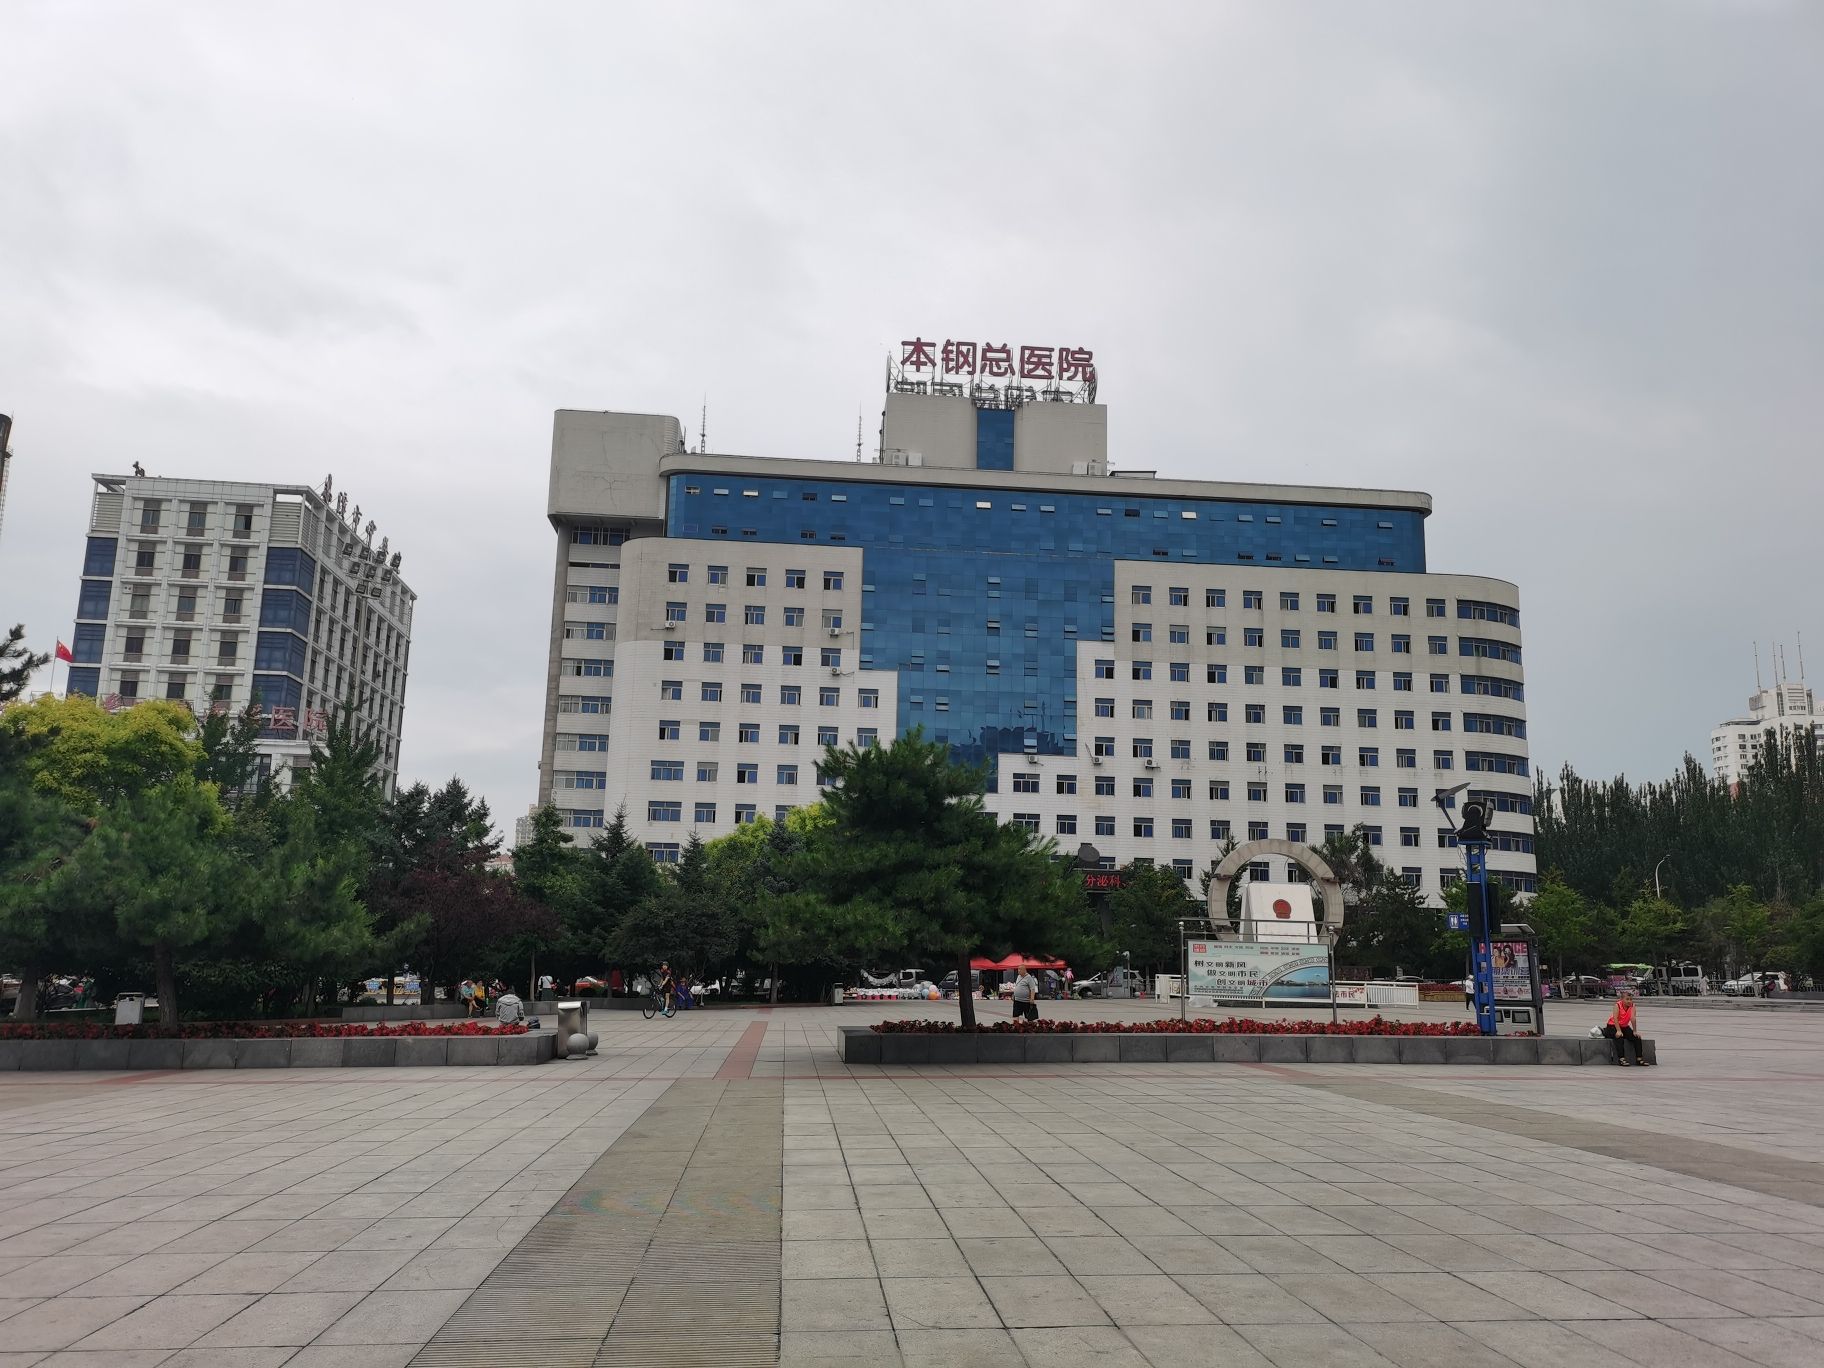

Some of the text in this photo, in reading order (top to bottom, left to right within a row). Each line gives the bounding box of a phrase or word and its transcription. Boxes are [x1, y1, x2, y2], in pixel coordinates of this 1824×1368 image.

[901, 337, 1096, 382] 本钢总医院
